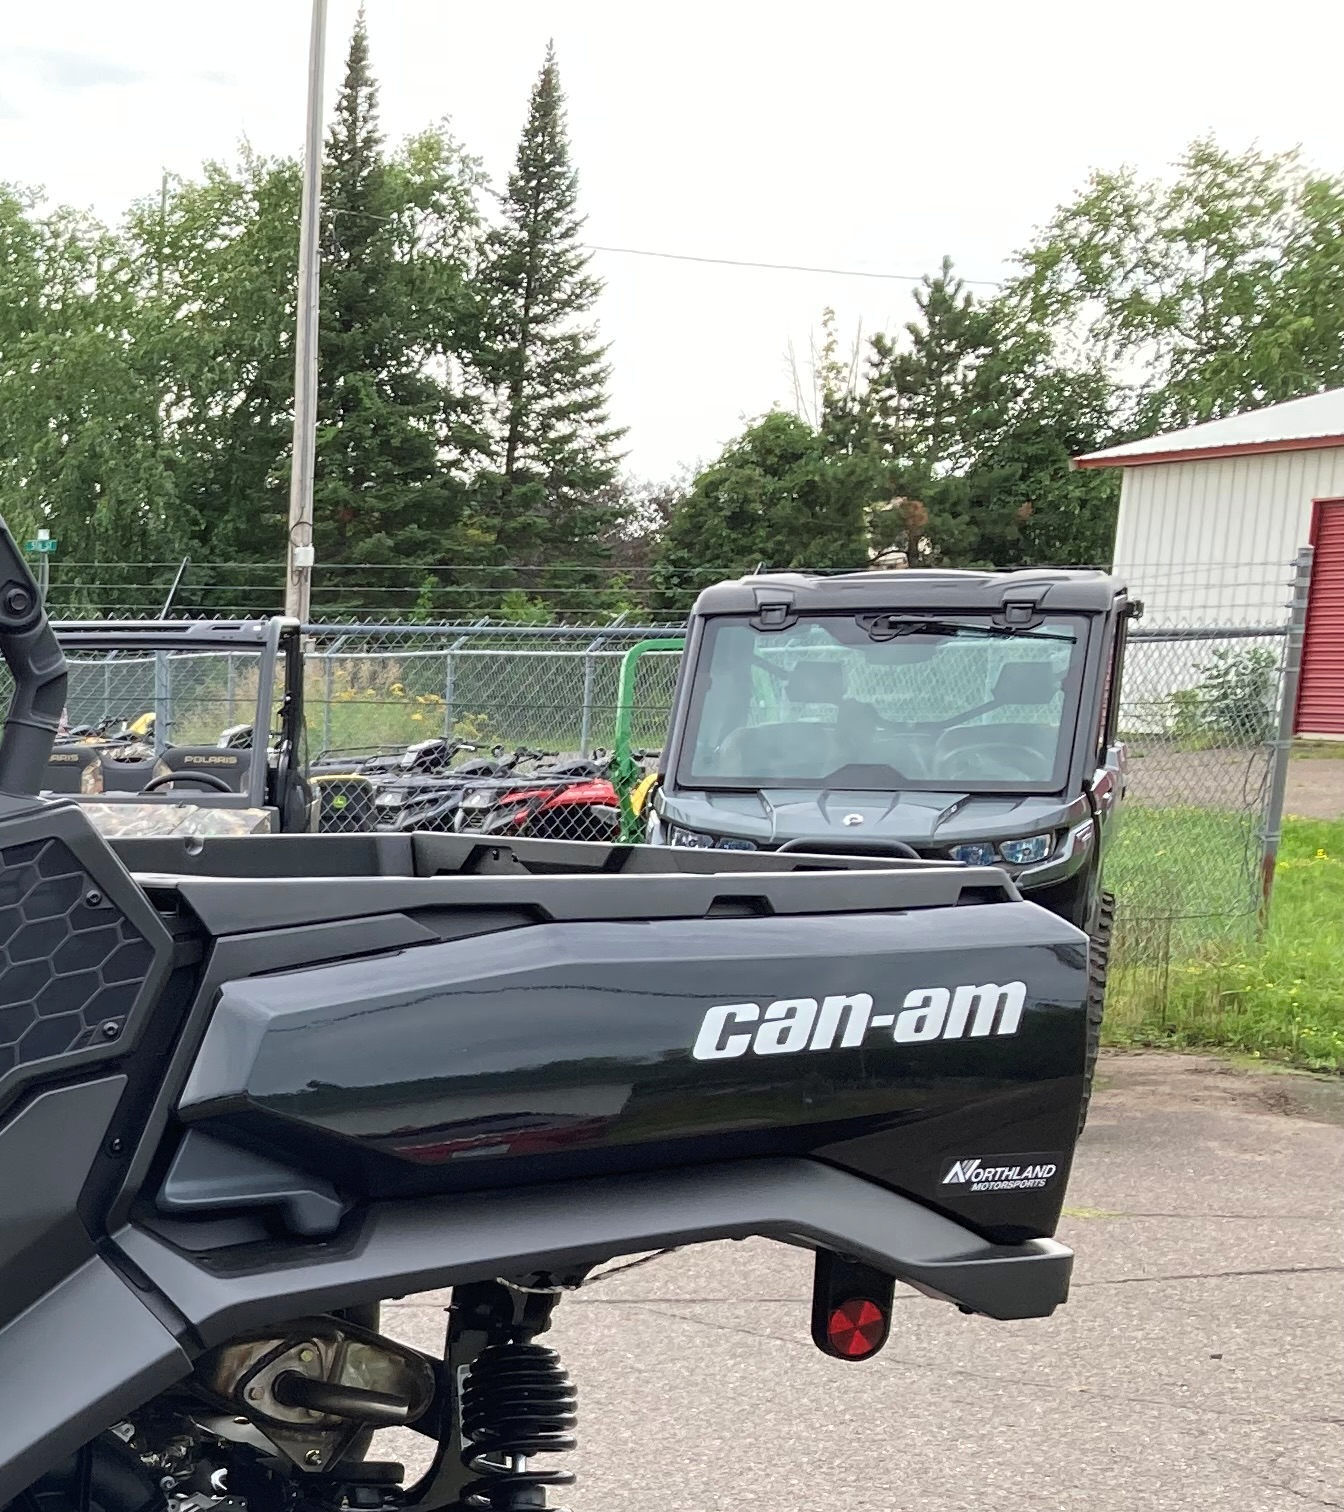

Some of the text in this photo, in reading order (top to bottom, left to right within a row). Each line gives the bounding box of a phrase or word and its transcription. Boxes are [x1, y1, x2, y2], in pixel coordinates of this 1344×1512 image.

[48, 753, 79, 763] ARIS
[184, 754, 238, 764] POLARIS
[692, 981, 1027, 1060] can-am
[942, 1158, 1057, 1184] NORTHLAND
[971, 1178, 1046, 1192] MOTORSPORTS
